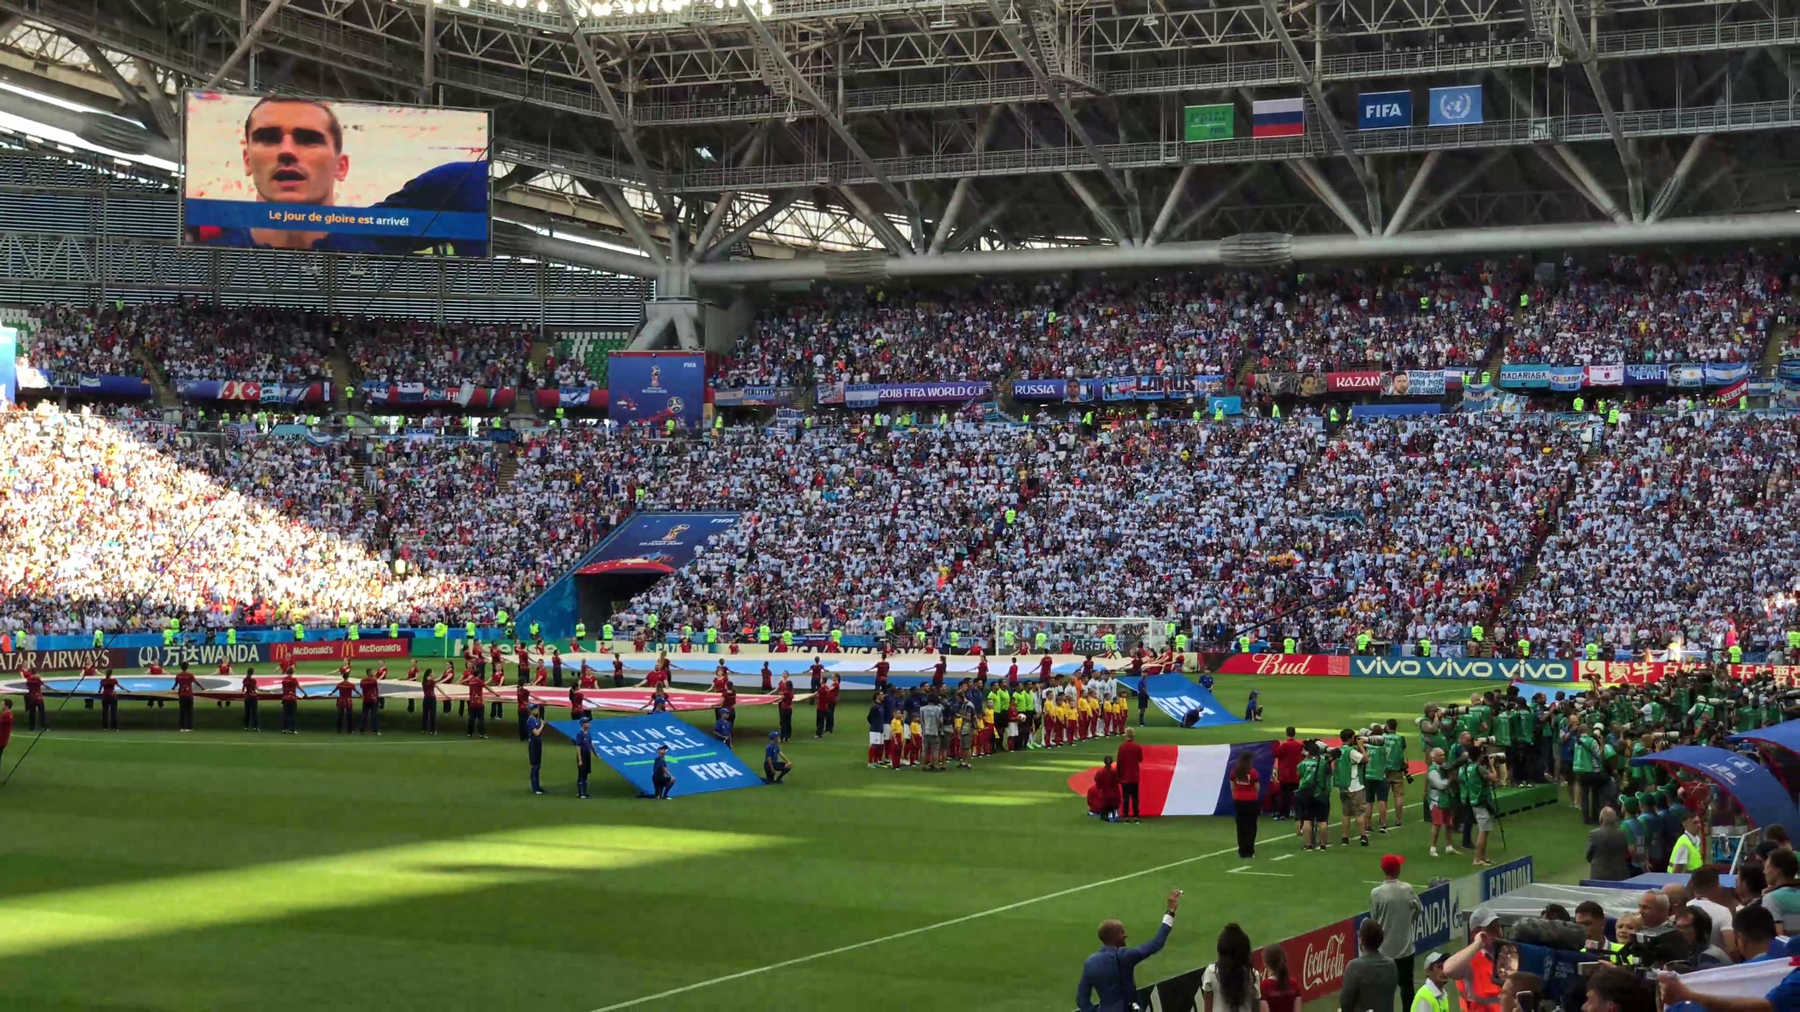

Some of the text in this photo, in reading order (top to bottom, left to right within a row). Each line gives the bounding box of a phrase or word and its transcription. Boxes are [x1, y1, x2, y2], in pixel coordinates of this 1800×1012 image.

[1365, 103, 1402, 119] FIFA
[268, 210, 281, 220] Le
[283, 211, 306, 222] jour
[308, 212, 323, 222] de
[324, 213, 356, 225] gloire
[357, 217, 374, 225] est
[1015, 384, 1056, 395] RUSSIA
[1336, 376, 1381, 388] KAZAN
[880, 388, 903, 399] 2018
[904, 387, 926, 398] FIFA
[928, 386, 966, 398] WORLD
[200, 644, 260, 664] WANDA
[293, 645, 334, 656] McDonald's
[359, 644, 402, 653] McDonald's
[41, 649, 110, 669] AIRWAYS
[1252, 653, 1312, 675] Bud
[1356, 656, 1567, 679] vivo vivo vivo
[688, 761, 743, 781] FIFA
